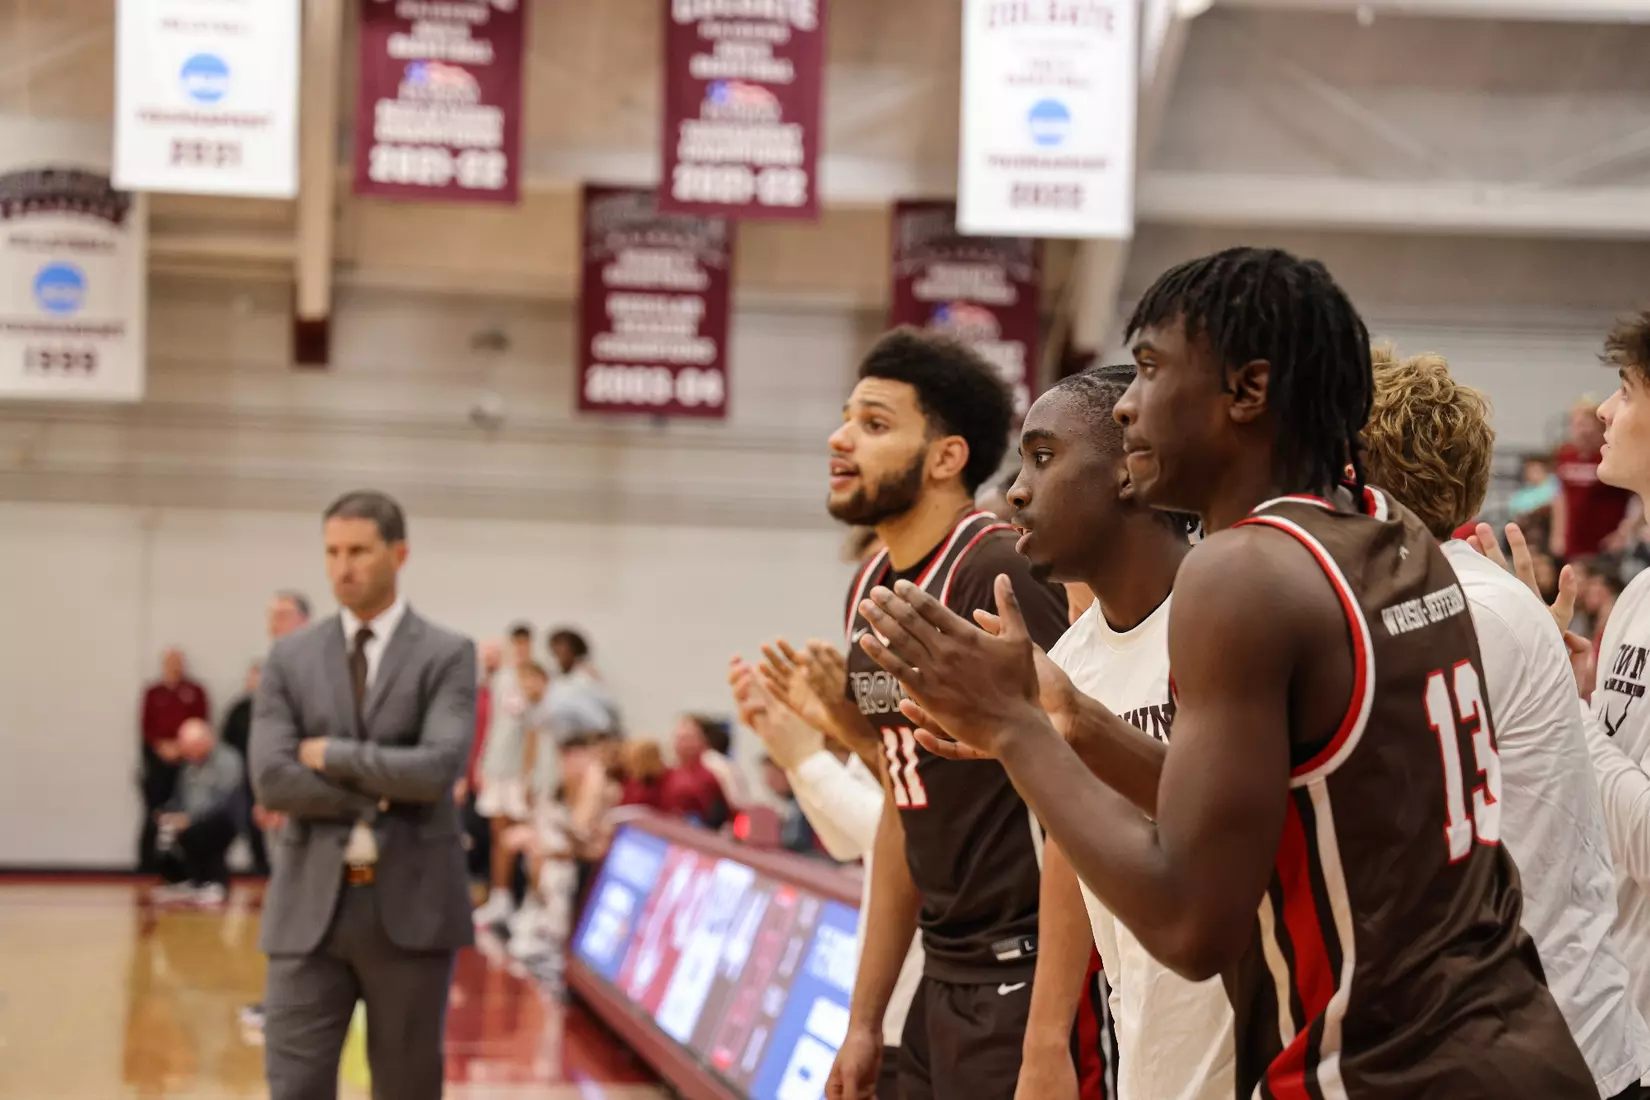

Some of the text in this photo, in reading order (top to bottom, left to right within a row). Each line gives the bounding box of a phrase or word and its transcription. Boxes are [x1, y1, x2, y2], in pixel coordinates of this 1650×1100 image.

[881, 725, 929, 809] 11
[1423, 658, 1500, 865] 13
[1023, 940, 1035, 952] L
